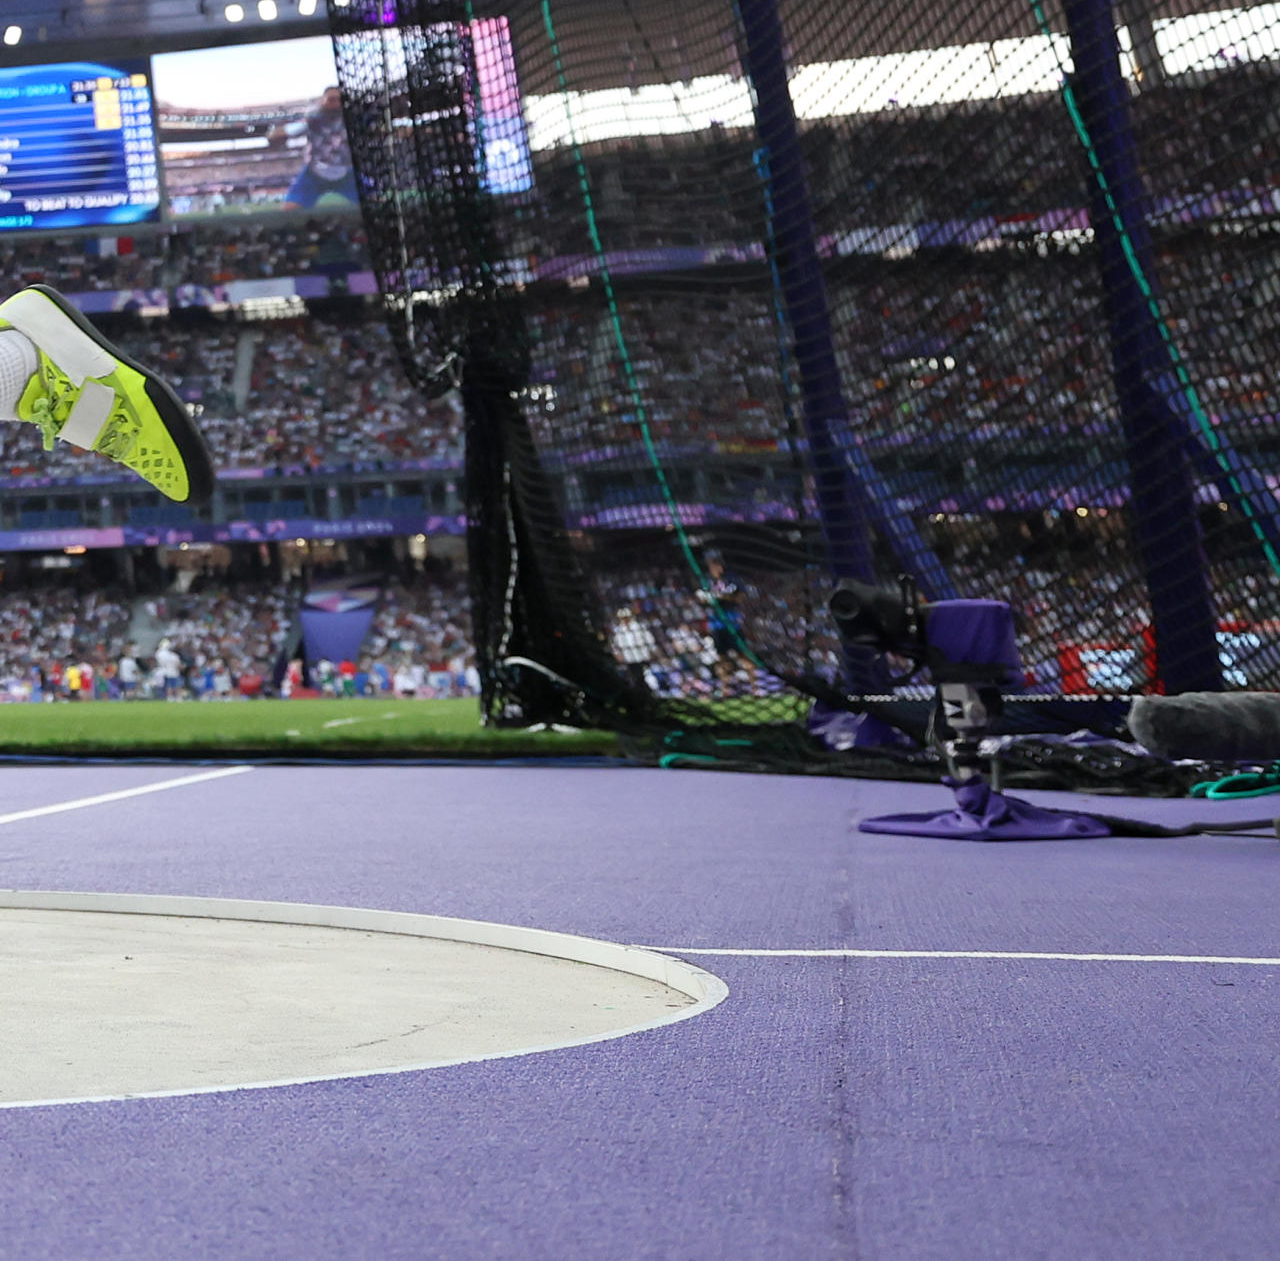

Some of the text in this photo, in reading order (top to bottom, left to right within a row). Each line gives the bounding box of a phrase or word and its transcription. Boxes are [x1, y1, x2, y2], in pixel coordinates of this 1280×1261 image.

[24, 198, 40, 212] TO
[40, 196, 67, 212] BEAT
[67, 195, 83, 210] TO
[83, 193, 128, 209] QUALIFY
